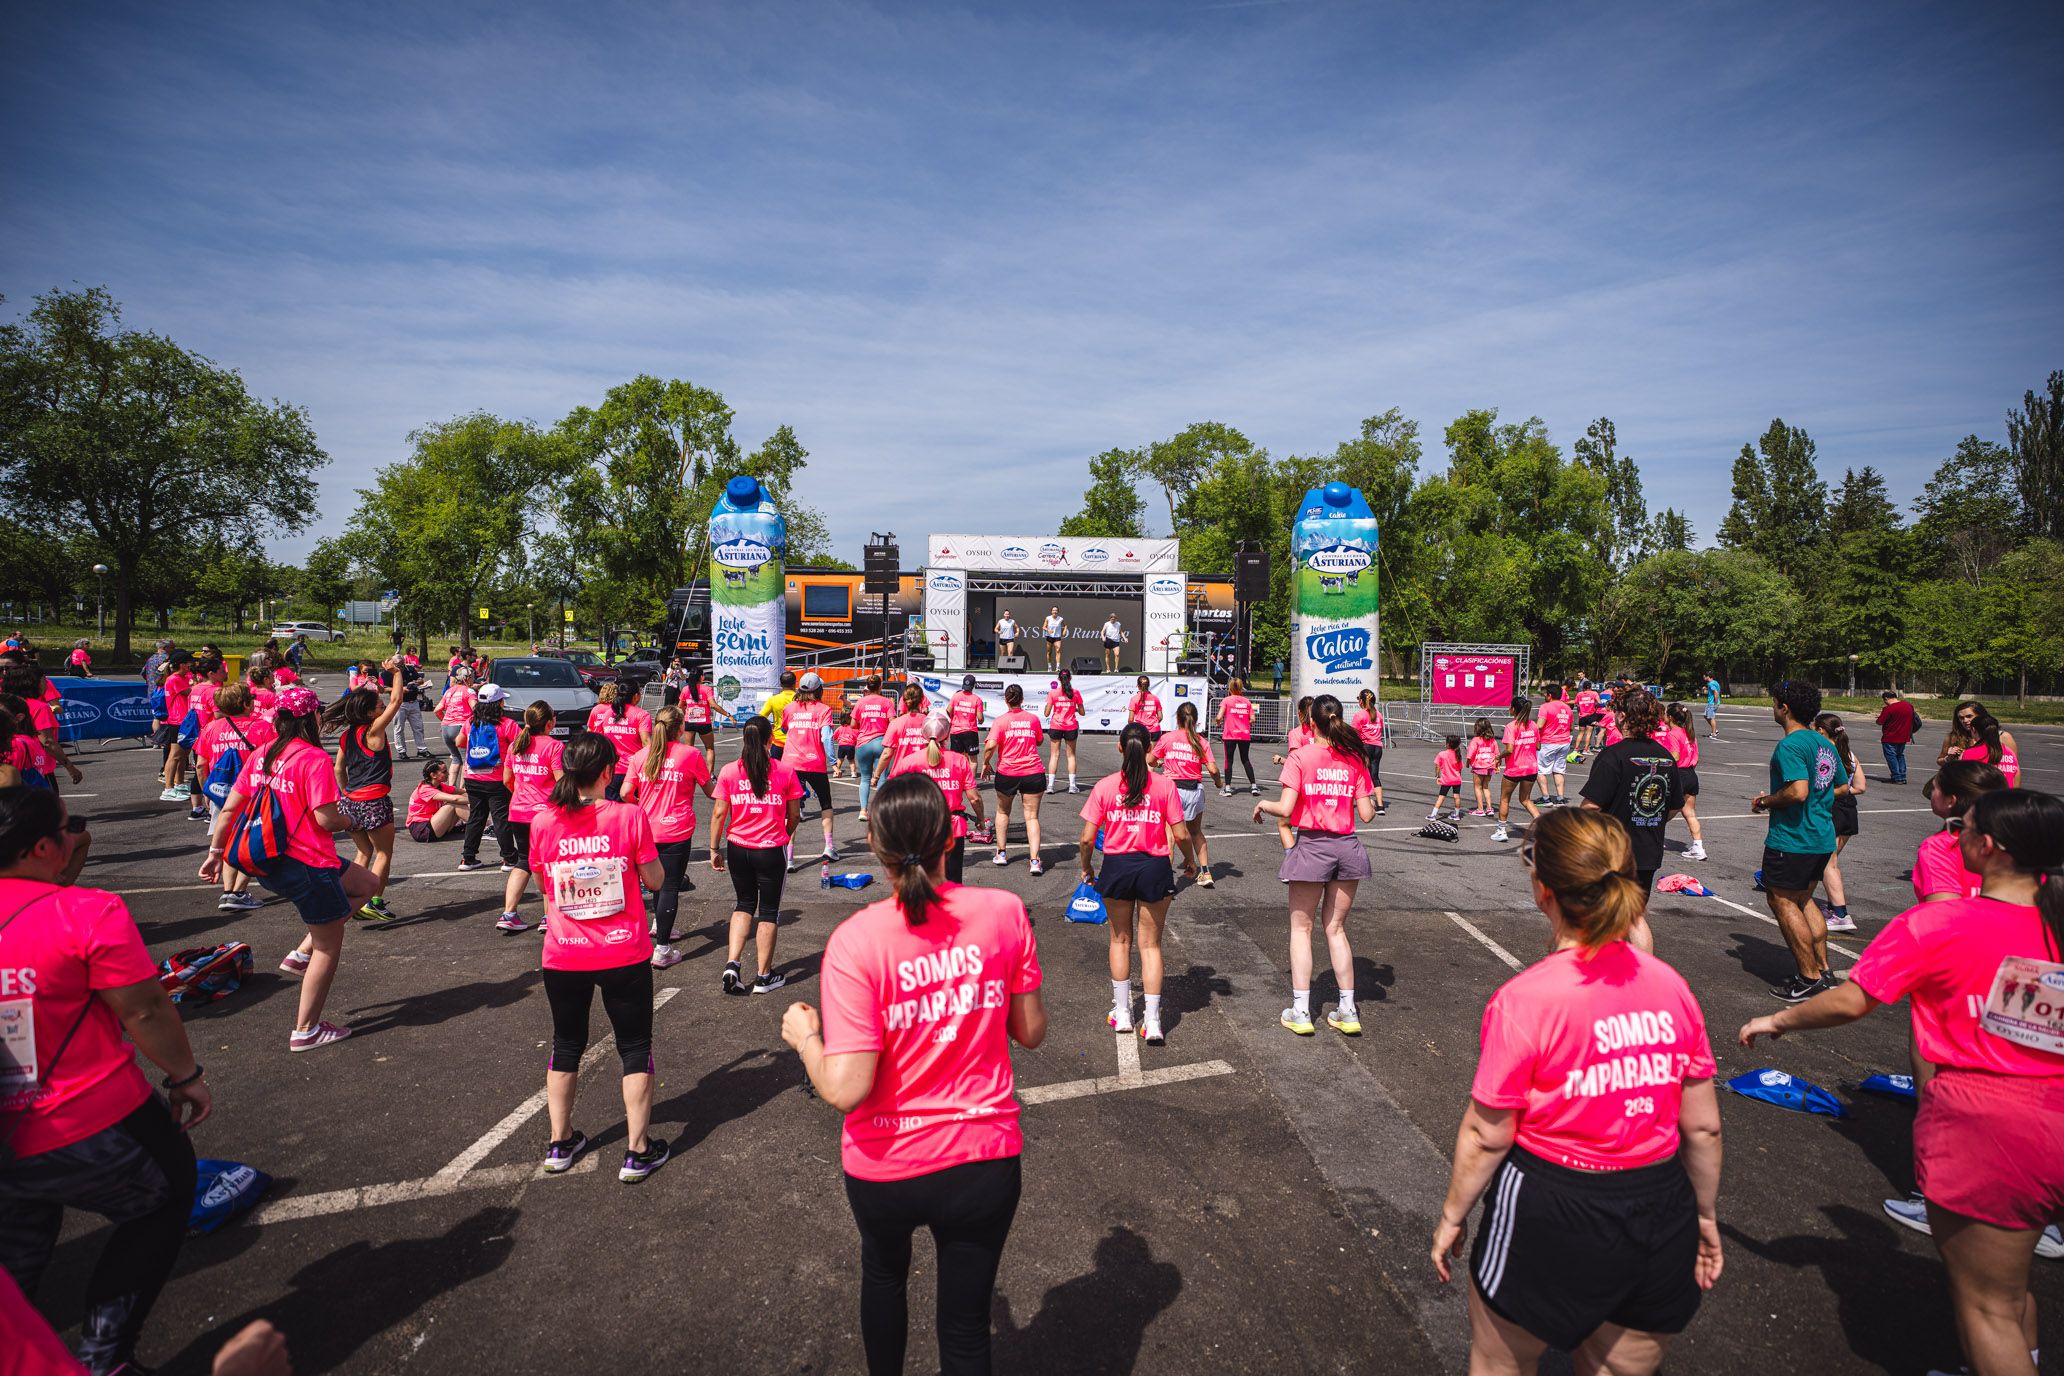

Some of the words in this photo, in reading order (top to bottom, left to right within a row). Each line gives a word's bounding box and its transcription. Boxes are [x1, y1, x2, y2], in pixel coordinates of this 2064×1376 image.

[717, 549, 767, 560] ASTURIANA
[1312, 556, 1367, 567] ASTURIANA
[932, 581, 960, 589] ASTURIANA
[930, 608, 960, 616] OYSHO
[717, 615, 746, 633] Leche
[716, 629, 771, 652] semi
[1312, 634, 1364, 659] Calcio
[716, 651, 773, 667] desnatada
[1335, 658, 1362, 670] natural
[1313, 676, 1362, 685] semidesnatada
[56, 709, 96, 720] URIANA
[1172, 742, 1193, 752] SOMO
[1316, 768, 1349, 782] SOMOS
[1304, 783, 1356, 798] IMPARABLE
[1106, 809, 1161, 824] IMPARABLES
[559, 835, 610, 857] SOMOS
[577, 887, 602, 898] 016
[558, 937, 589, 945] OYSHO
[898, 944, 983, 992] SOMOS
[1594, 1010, 1676, 1055] SOMOS
[1996, 1026, 2040, 1042] OYSHO
[873, 1115, 922, 1130] OYSHO
